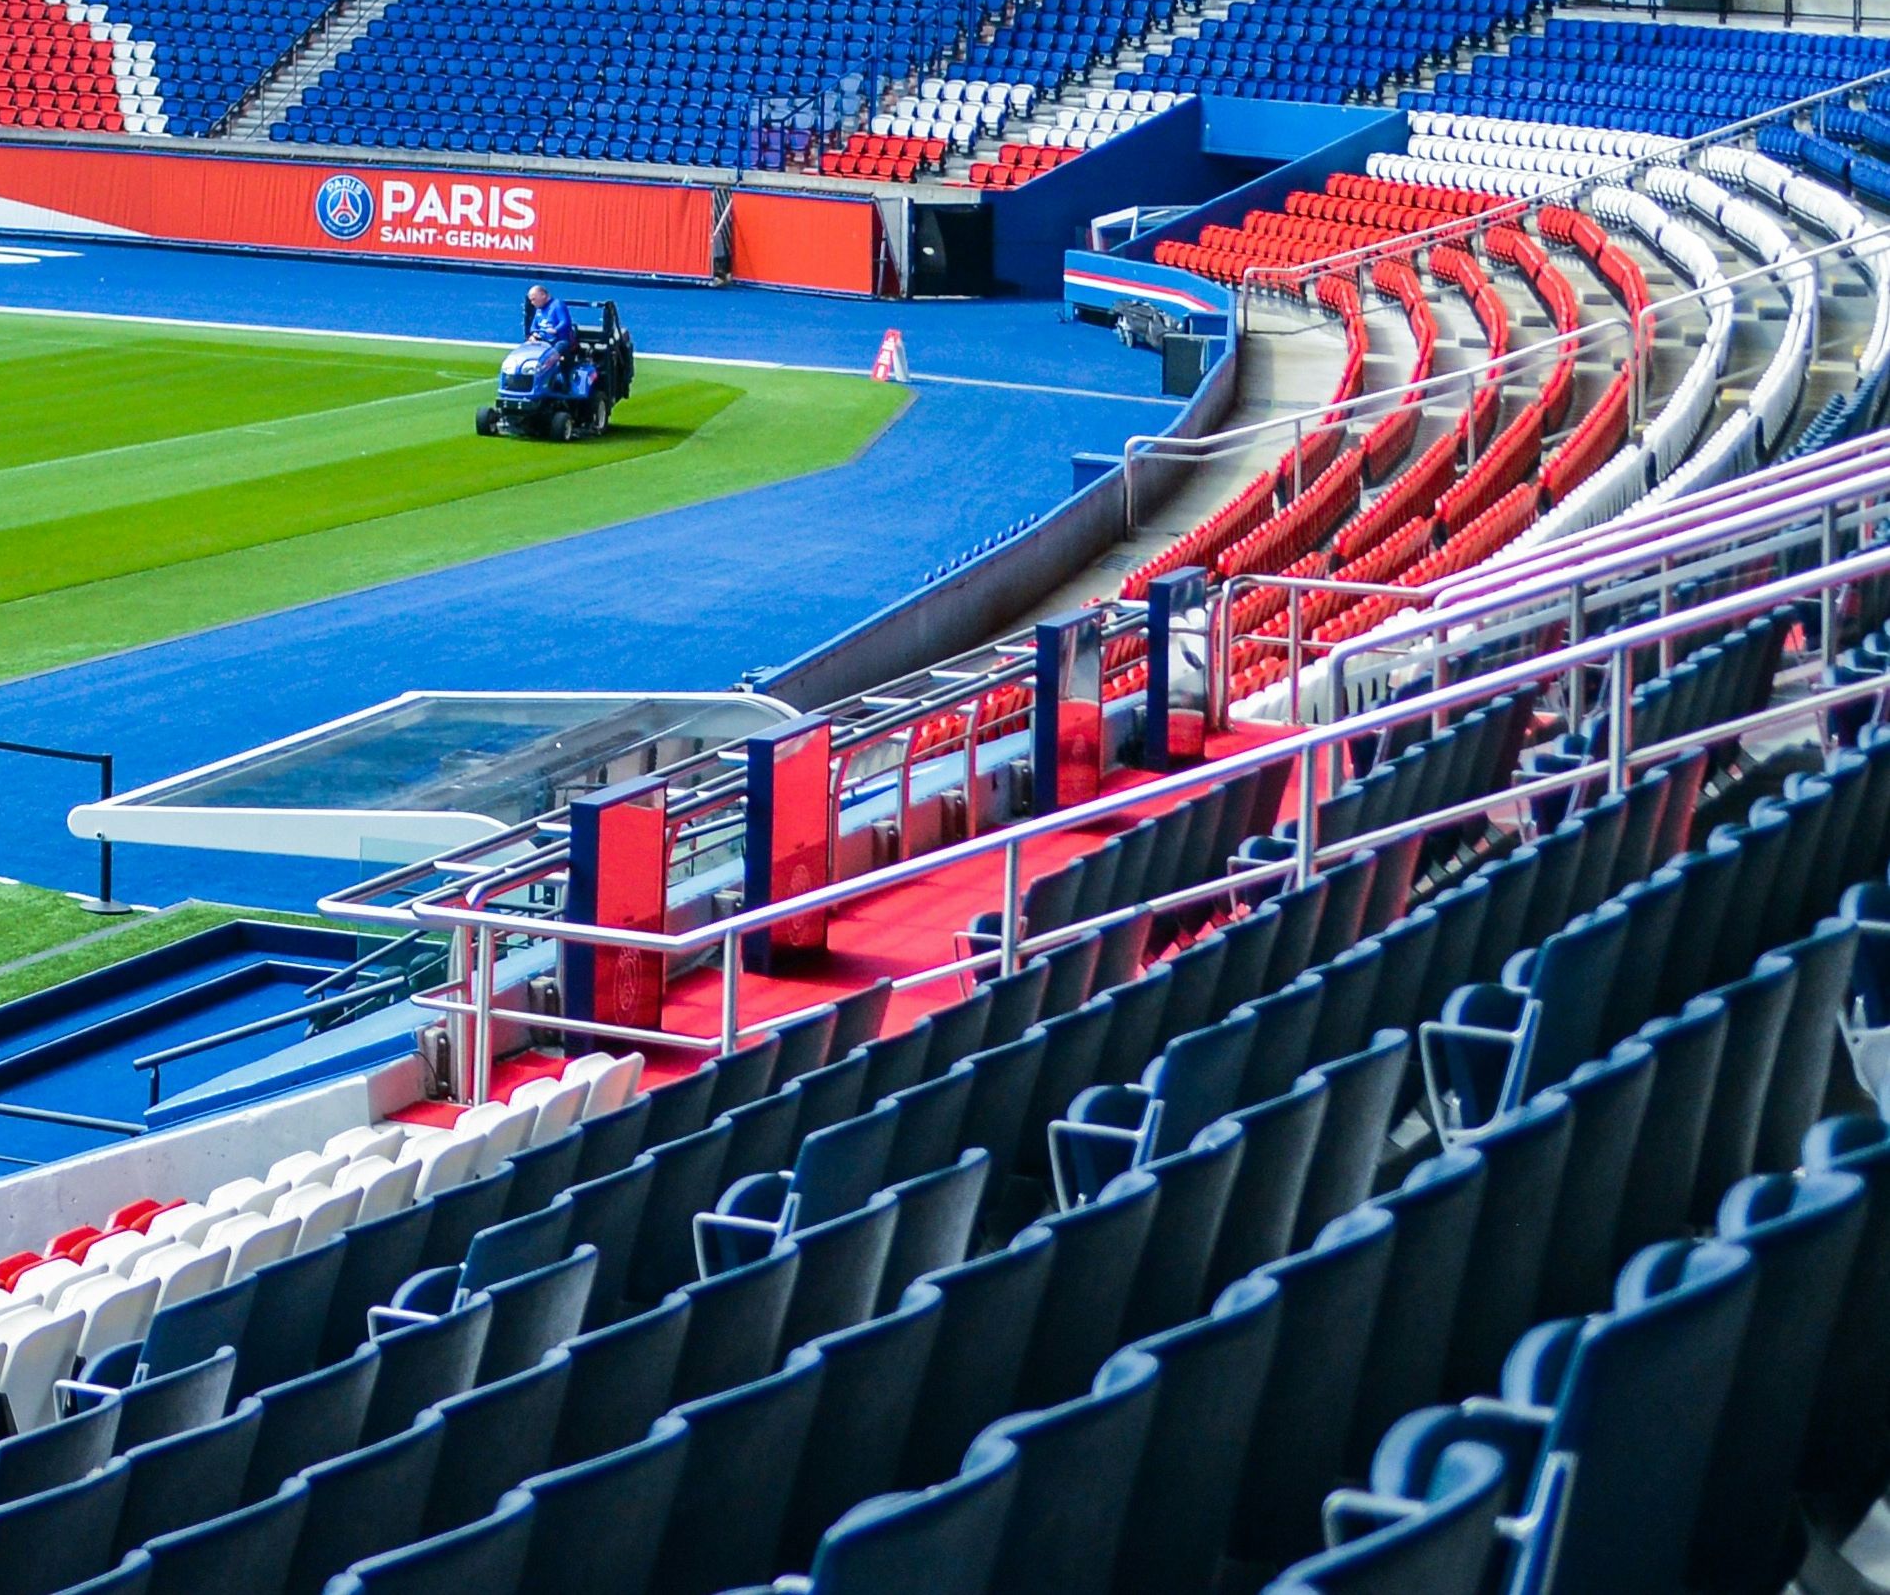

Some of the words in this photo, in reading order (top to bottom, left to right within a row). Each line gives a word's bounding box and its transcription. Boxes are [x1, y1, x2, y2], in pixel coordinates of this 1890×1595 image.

[326, 178, 365, 195] PARIS
[381, 180, 536, 229] PARIS
[379, 226, 534, 251] SAINT-GERMAIN
